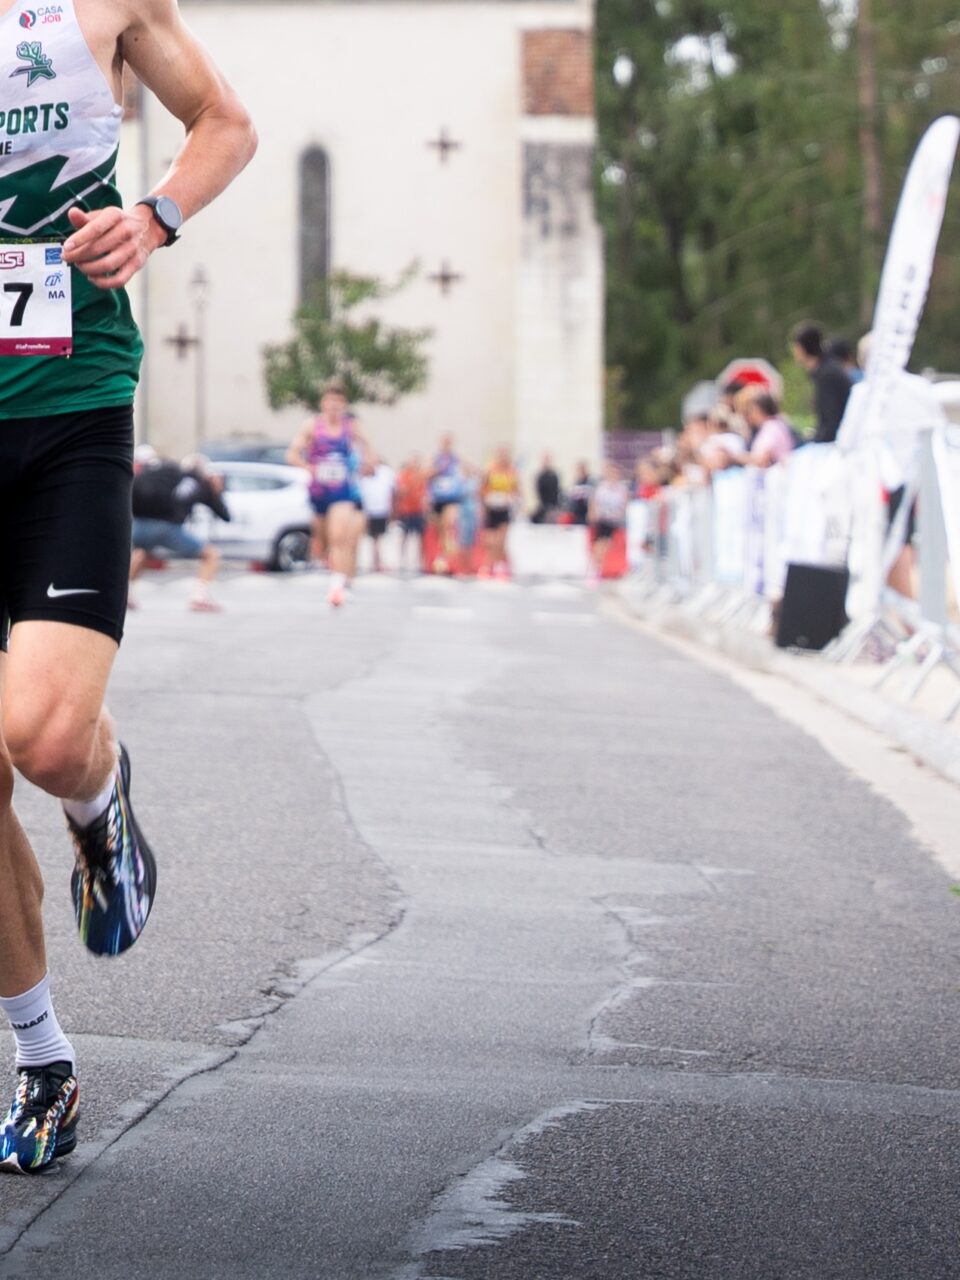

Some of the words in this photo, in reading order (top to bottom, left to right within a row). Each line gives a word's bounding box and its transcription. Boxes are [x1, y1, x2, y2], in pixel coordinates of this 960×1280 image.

[37, 5, 63, 16] CASA
[41, 14, 61, 24] JOB
[48, 290, 65, 299] MA
